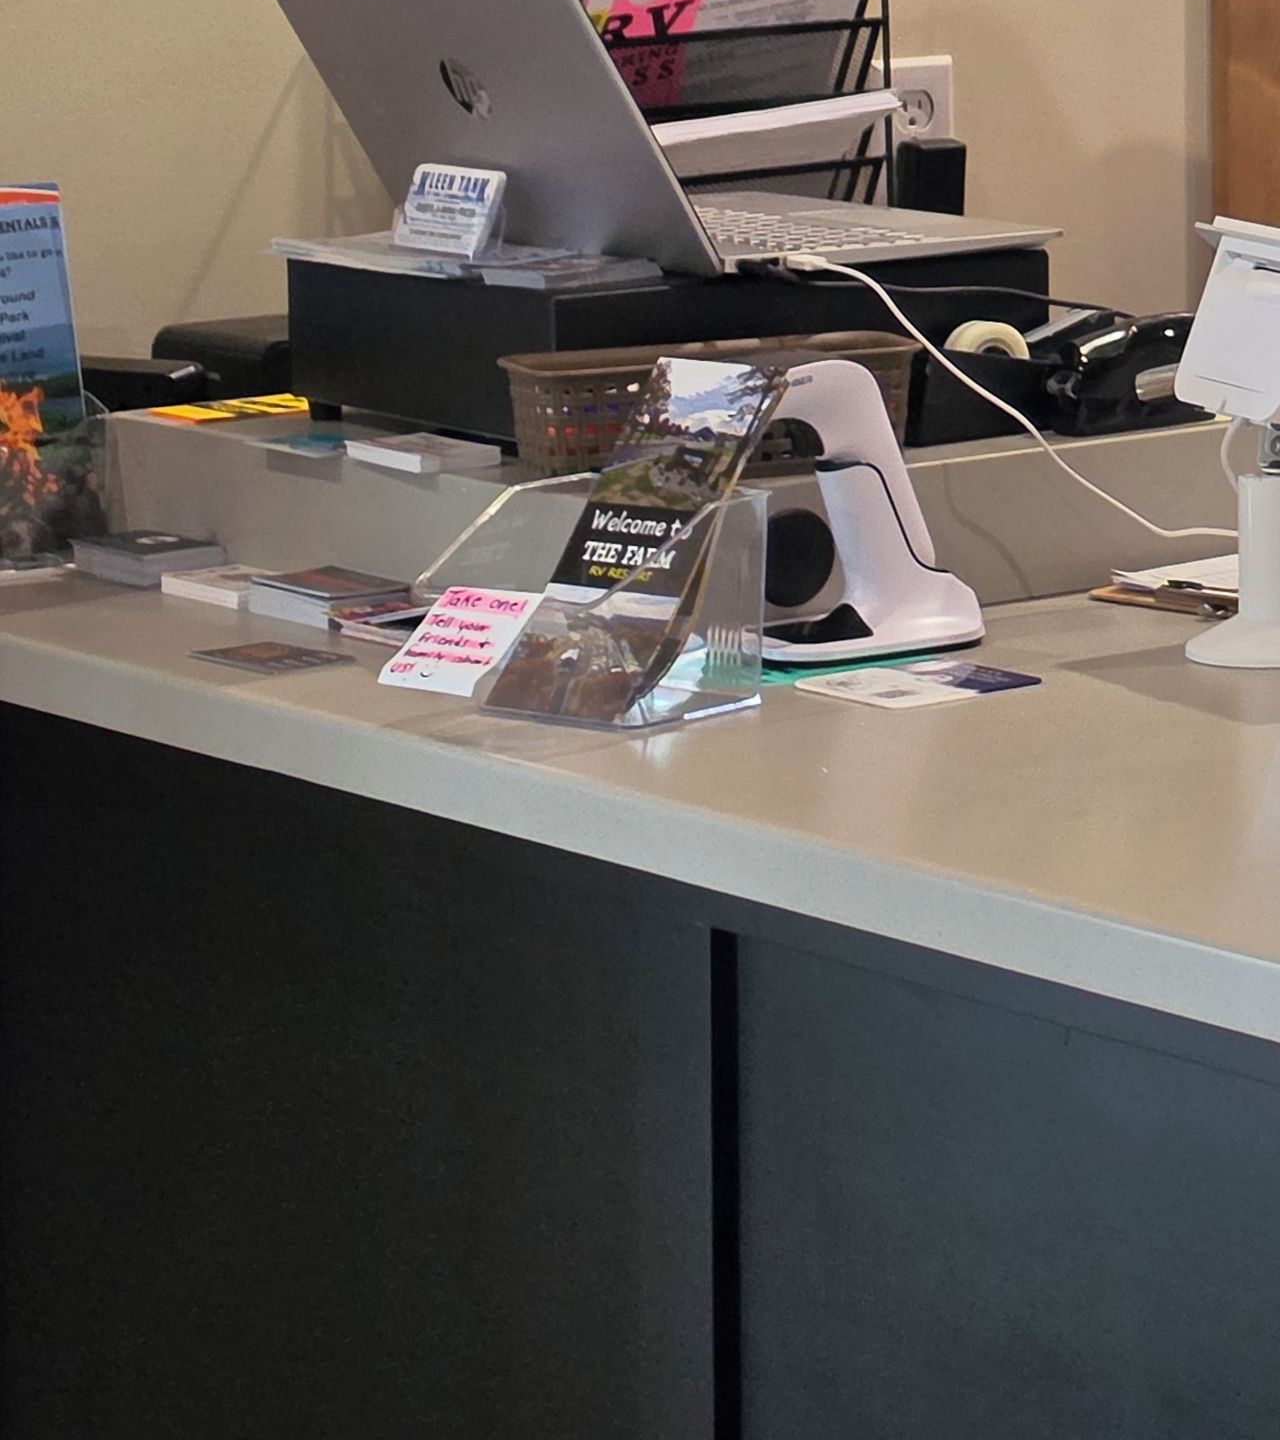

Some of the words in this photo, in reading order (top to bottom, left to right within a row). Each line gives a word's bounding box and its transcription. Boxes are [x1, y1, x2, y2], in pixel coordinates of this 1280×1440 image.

[0, 308, 29, 324] Park
[591, 509, 667, 537] Welcome
[582, 541, 622, 563] THE
[621, 545, 676, 569] FARM
[589, 565, 607, 576] RV
[607, 567, 653, 581] RESRT
[432, 614, 451, 628] Tell
[457, 621, 490, 634] your
